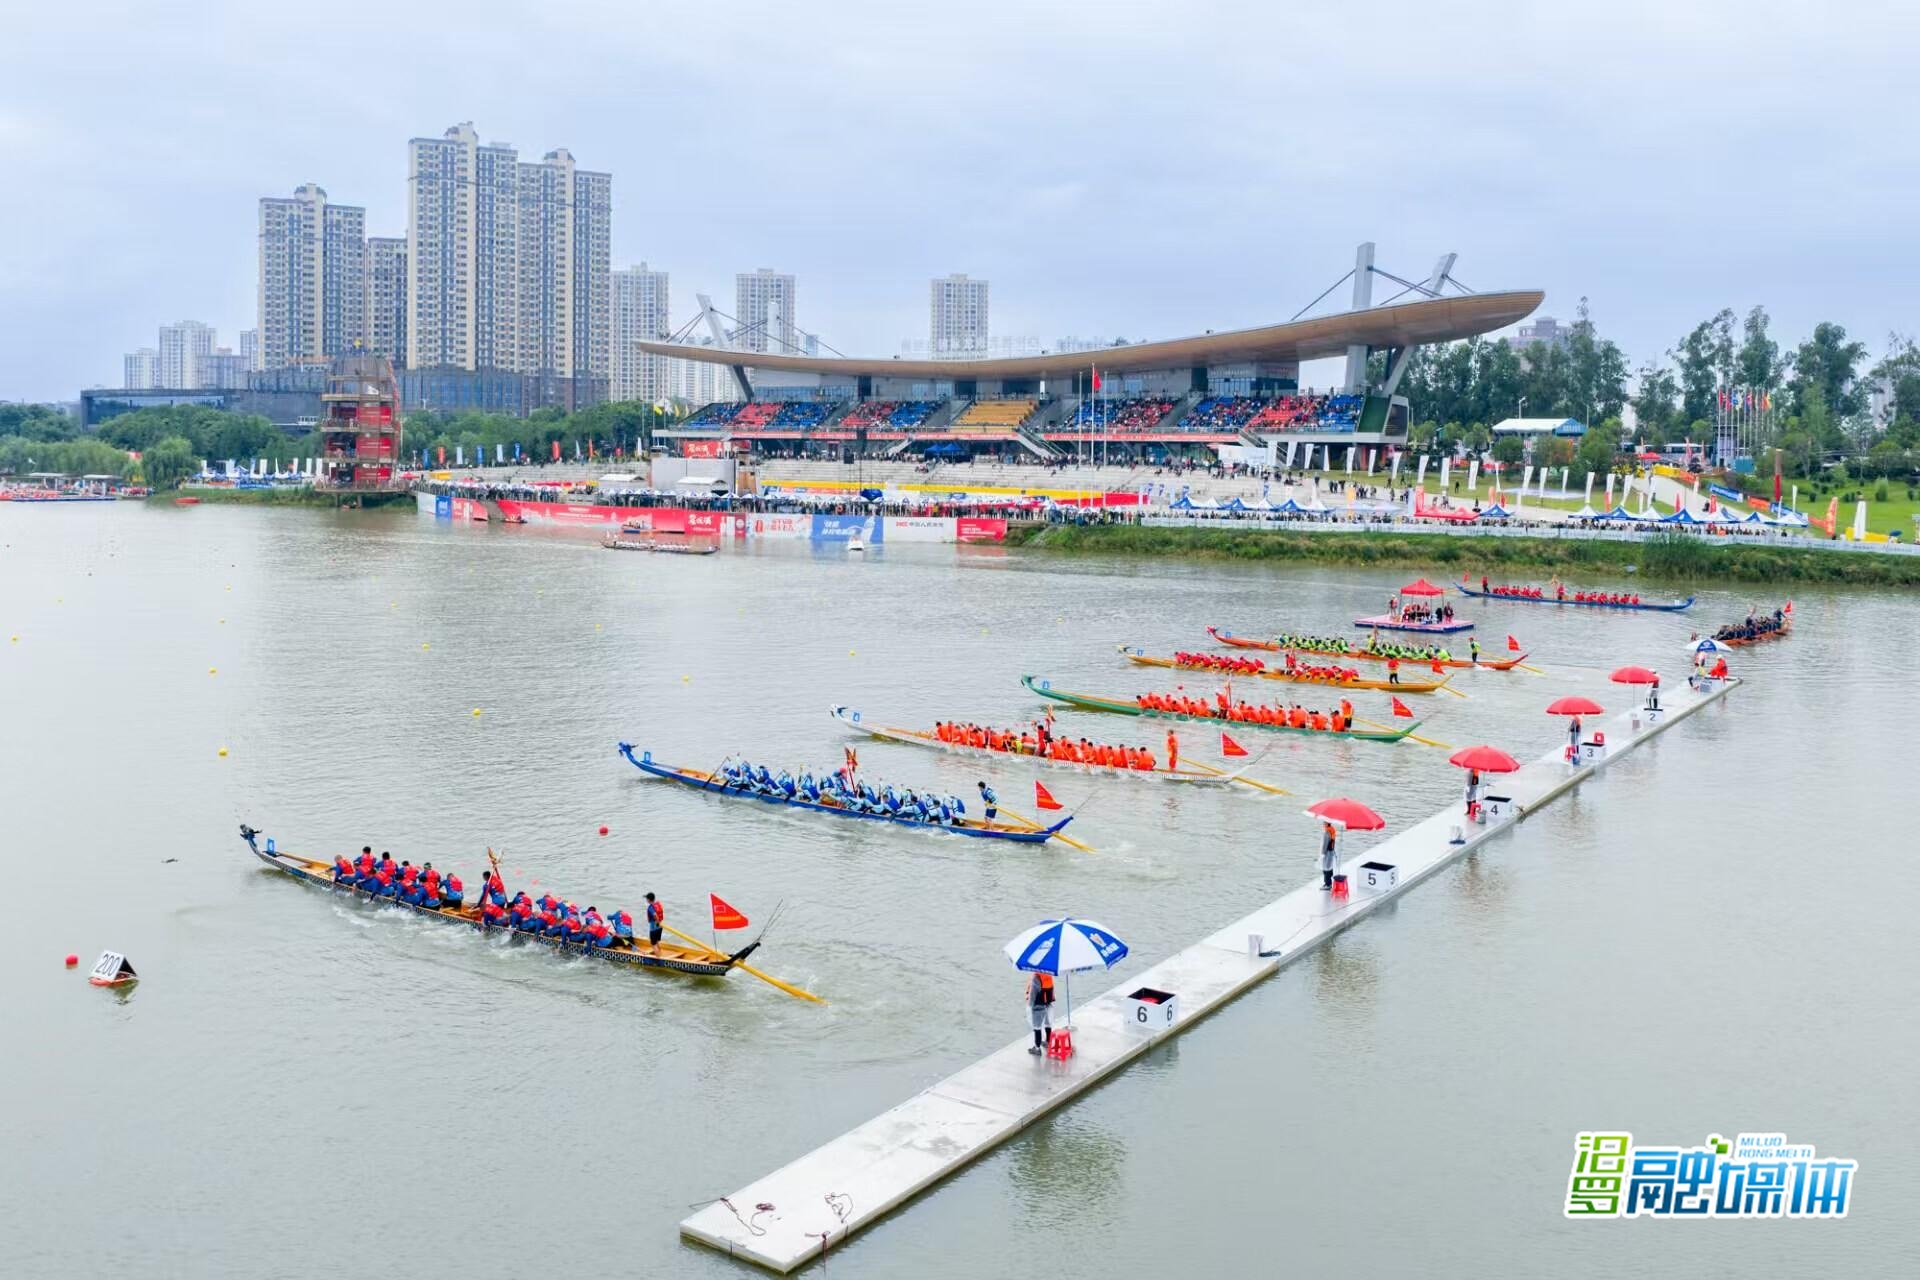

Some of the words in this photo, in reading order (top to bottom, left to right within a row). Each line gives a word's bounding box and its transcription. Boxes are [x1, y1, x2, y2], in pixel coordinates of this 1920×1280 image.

[1587, 748, 1594, 758] 3
[1490, 804, 1499, 815] 4
[1368, 872, 1377, 886] 5
[95, 953, 121, 976] 200
[1137, 1006, 1148, 1022] 6
[1166, 1004, 1173, 1021] 6
